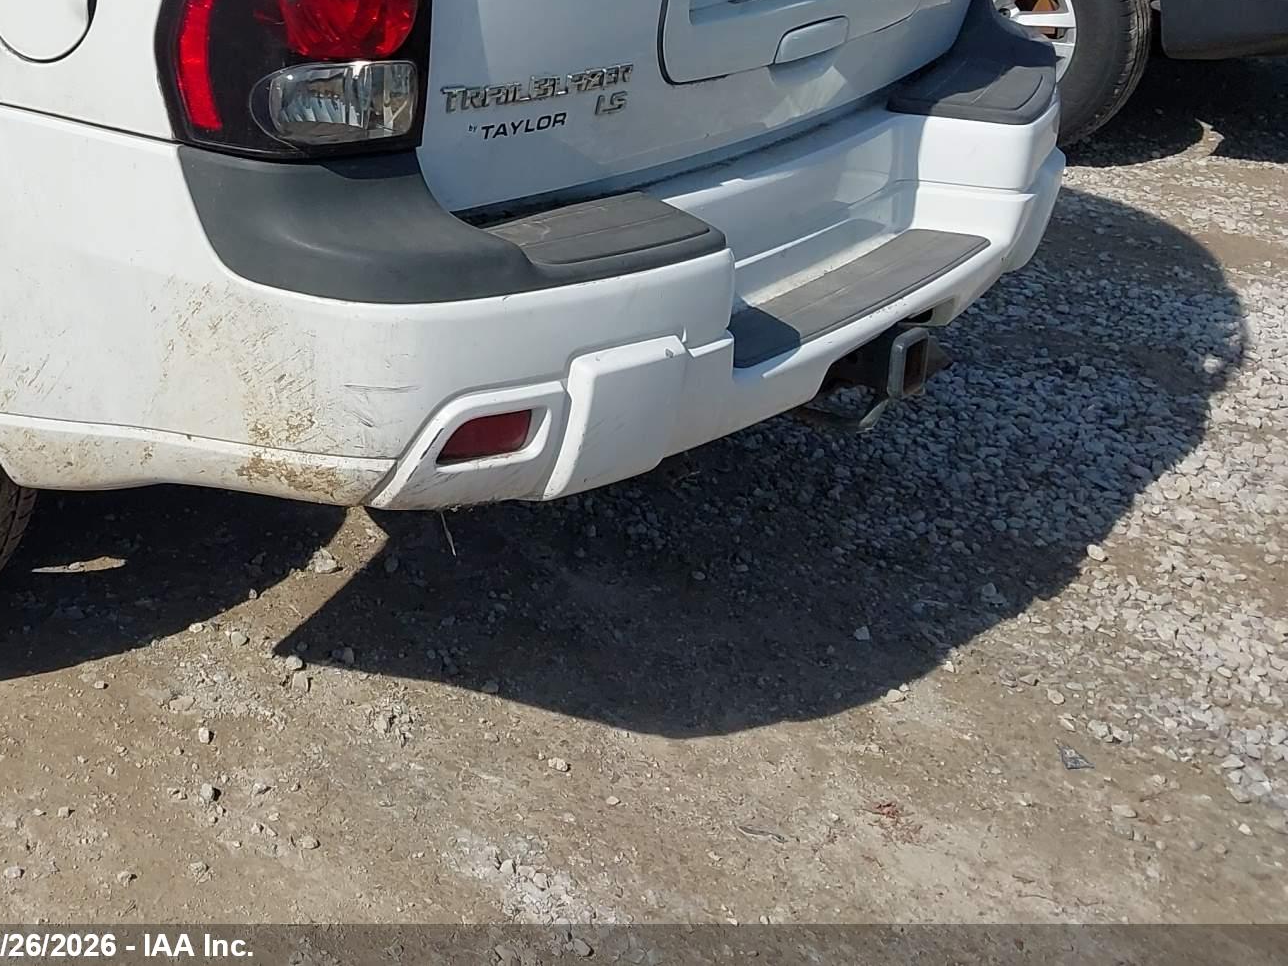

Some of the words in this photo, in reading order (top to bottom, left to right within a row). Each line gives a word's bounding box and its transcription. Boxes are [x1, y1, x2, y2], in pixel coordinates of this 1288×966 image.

[440, 62, 634, 114] TRAILBLAZER
[595, 90, 628, 117] LS
[481, 112, 567, 140] TAYLOR
